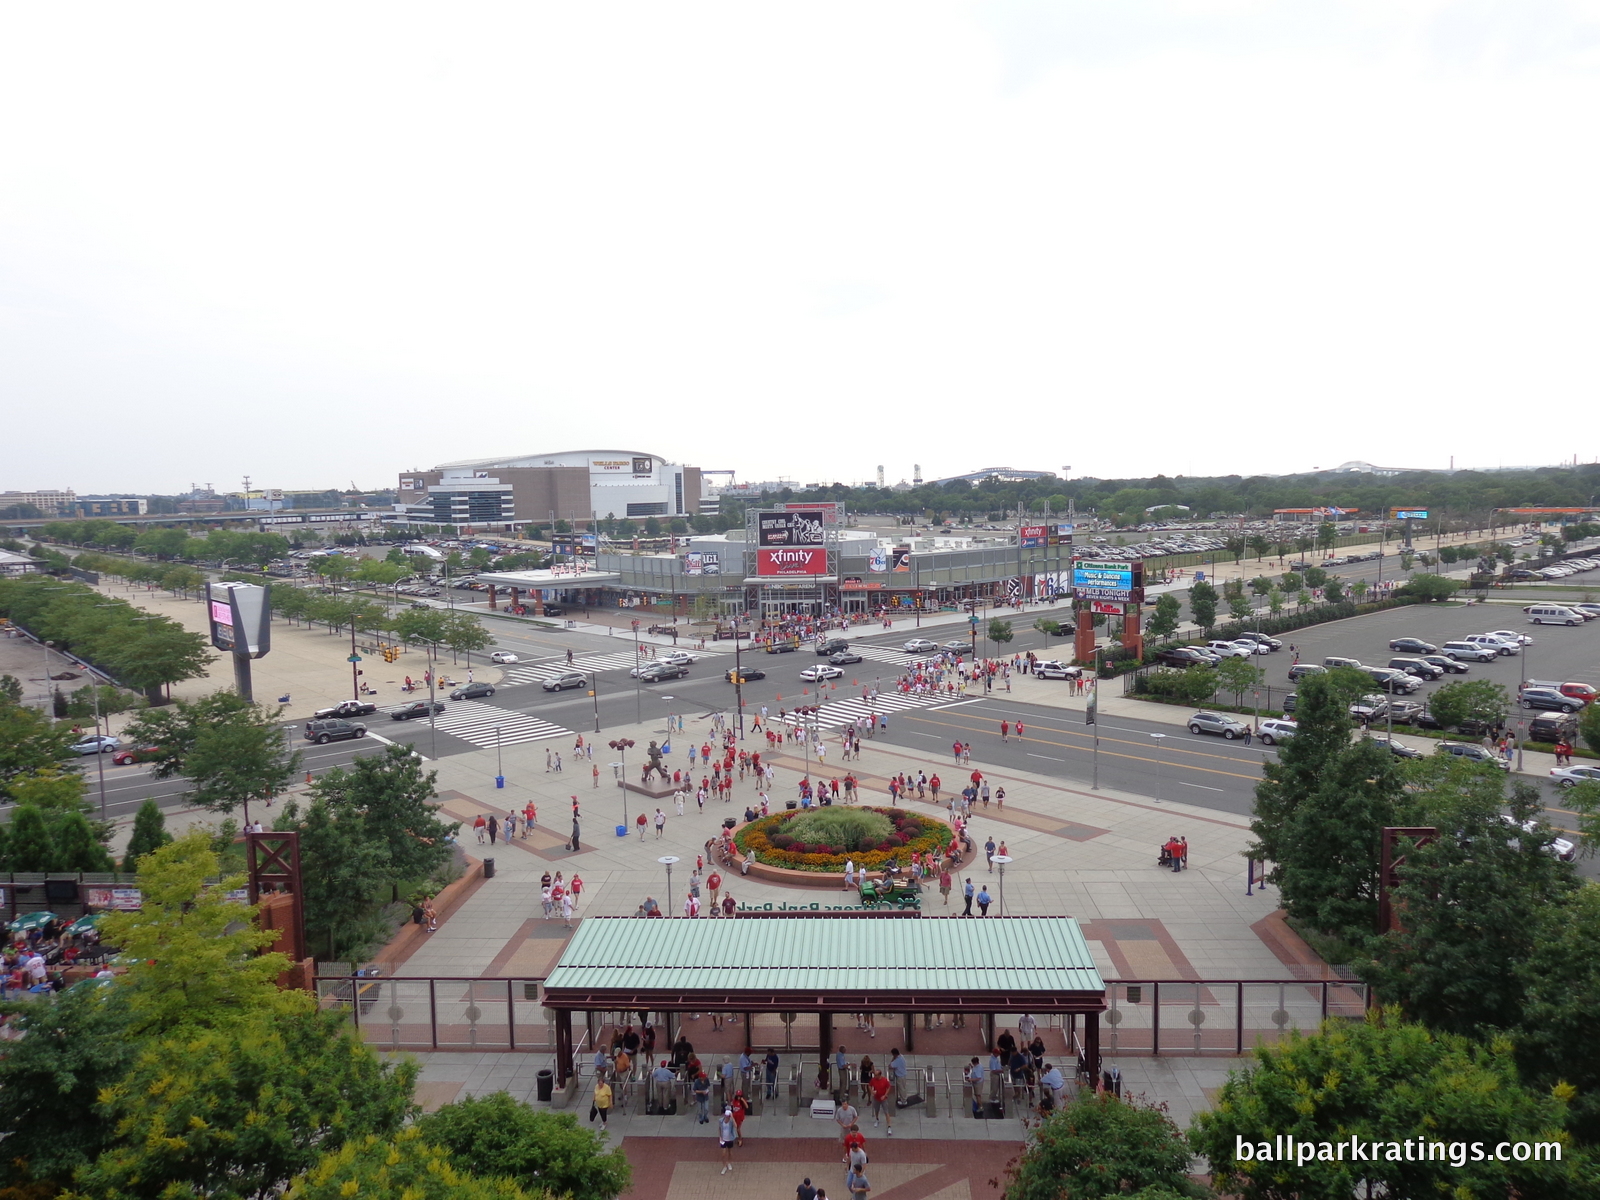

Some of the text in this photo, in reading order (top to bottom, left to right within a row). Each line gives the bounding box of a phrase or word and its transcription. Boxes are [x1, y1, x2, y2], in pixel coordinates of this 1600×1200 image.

[770, 549, 813, 565] xfinity
[550, 564, 589, 574] VALET
[1101, 589, 1130, 597] TONIGHT
[1093, 601, 1121, 613] Phillies
